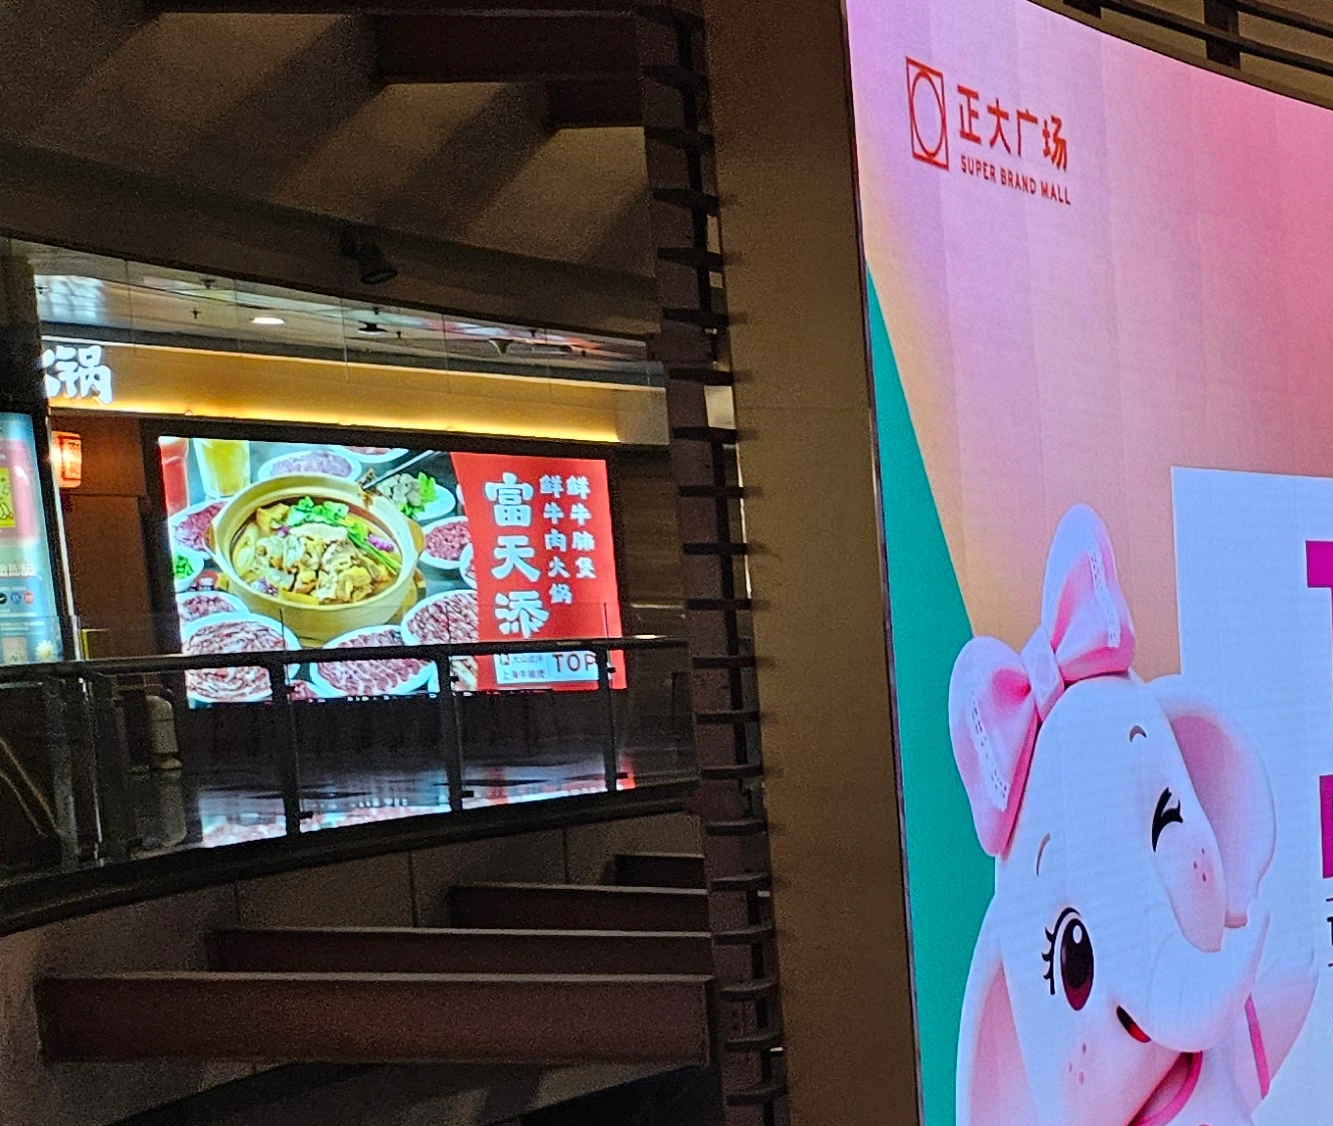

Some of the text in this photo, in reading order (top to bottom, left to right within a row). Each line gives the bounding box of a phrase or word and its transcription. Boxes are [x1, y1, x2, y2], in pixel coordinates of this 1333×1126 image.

[957, 84, 1067, 171] 正大广场
[961, 155, 1071, 205] SUPER BRAND MALL
[540, 474, 573, 604] 鲜牛肉火锅
